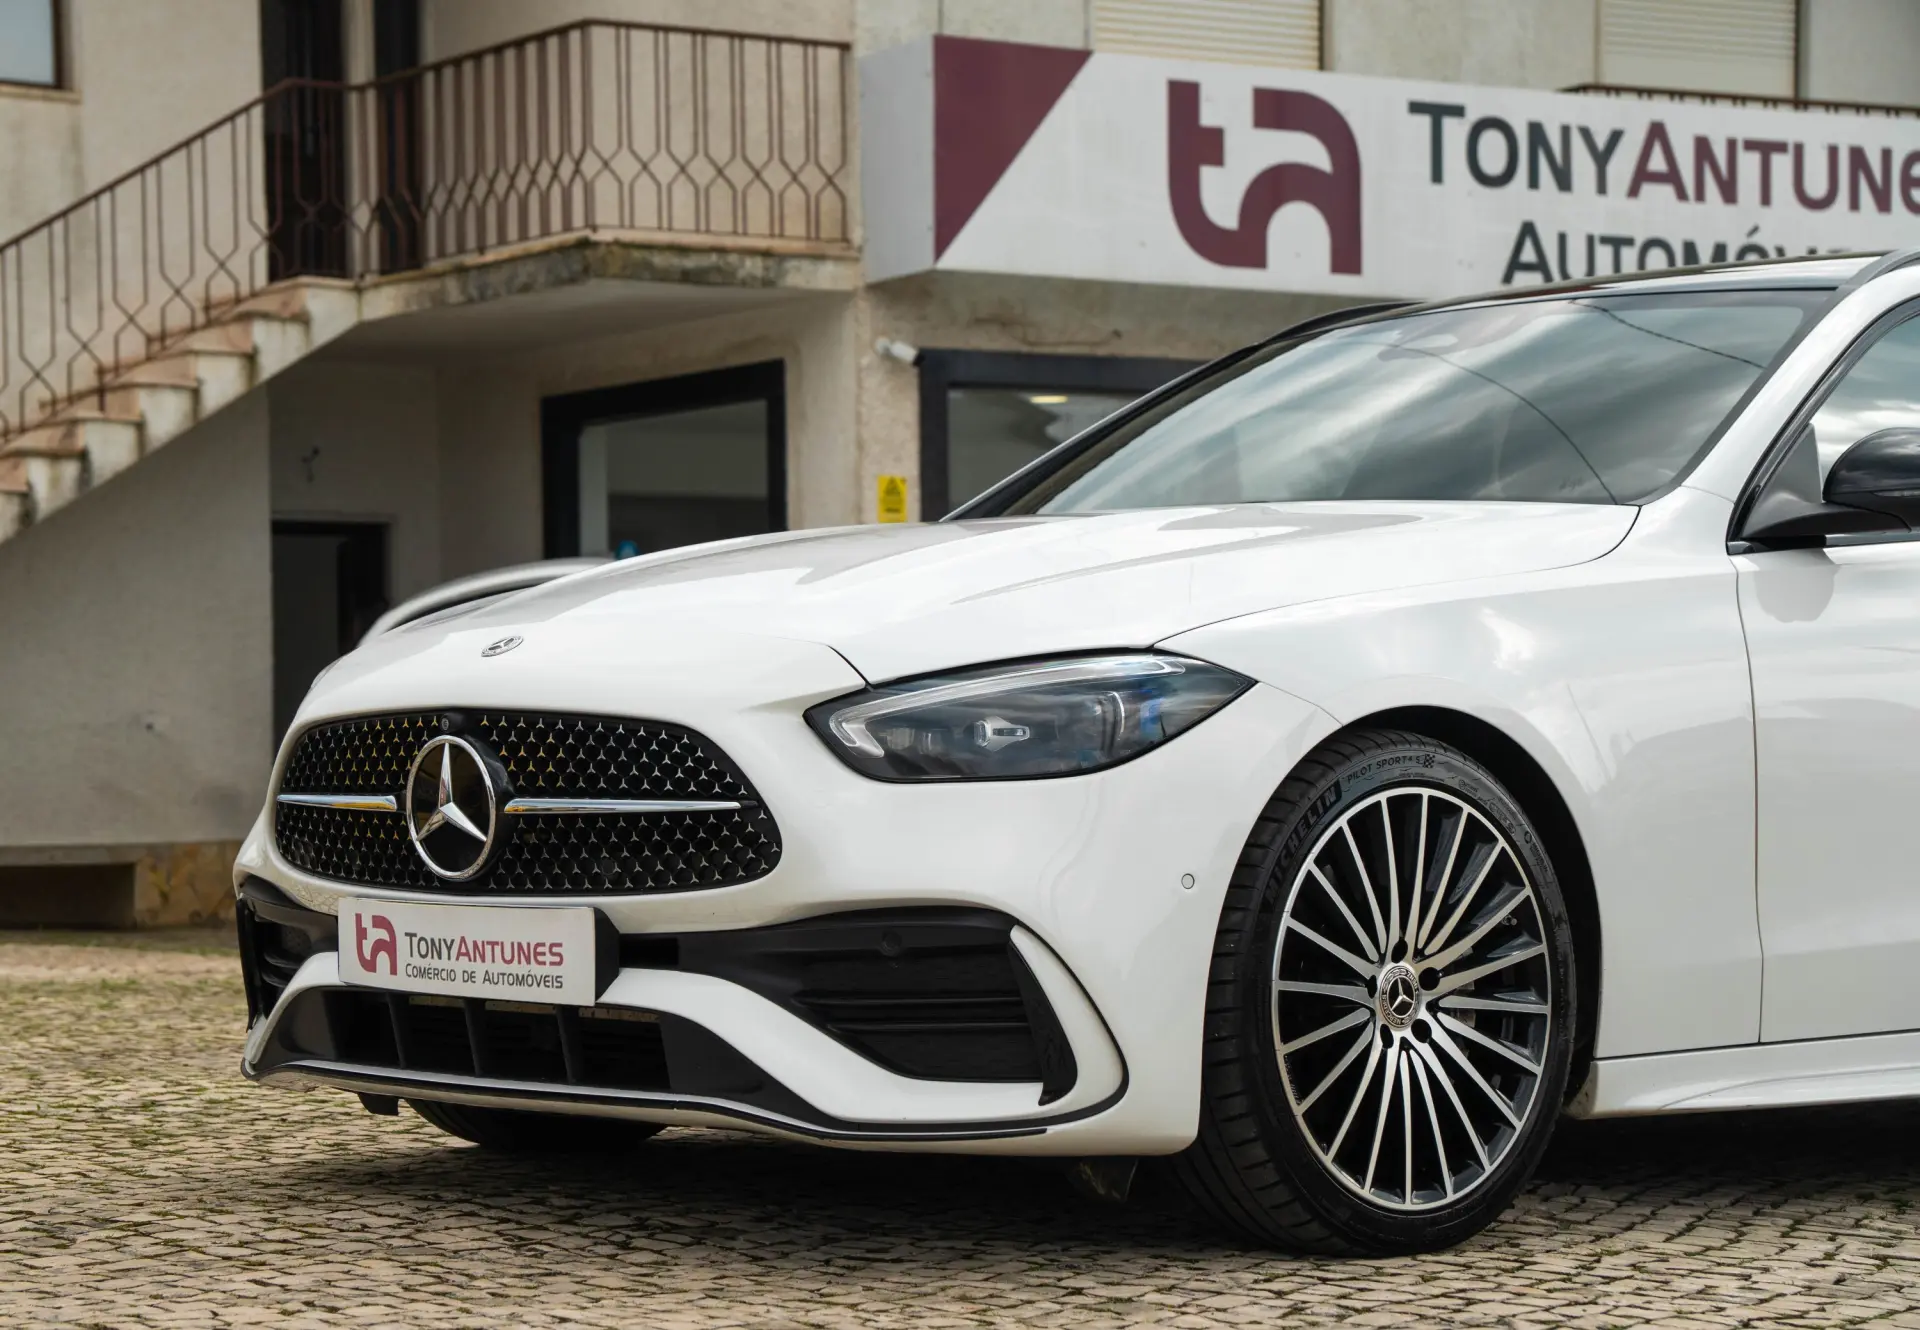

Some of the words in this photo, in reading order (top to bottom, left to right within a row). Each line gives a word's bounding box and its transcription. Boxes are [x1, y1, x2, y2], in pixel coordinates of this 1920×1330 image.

[1347, 763, 1373, 784] PILOT
[1264, 783, 1339, 906] MICHELIN
[405, 963, 457, 984] COMÉRCIO
[462, 970, 477, 984] DE
[482, 969, 563, 989] AUTOMÓVEIS
